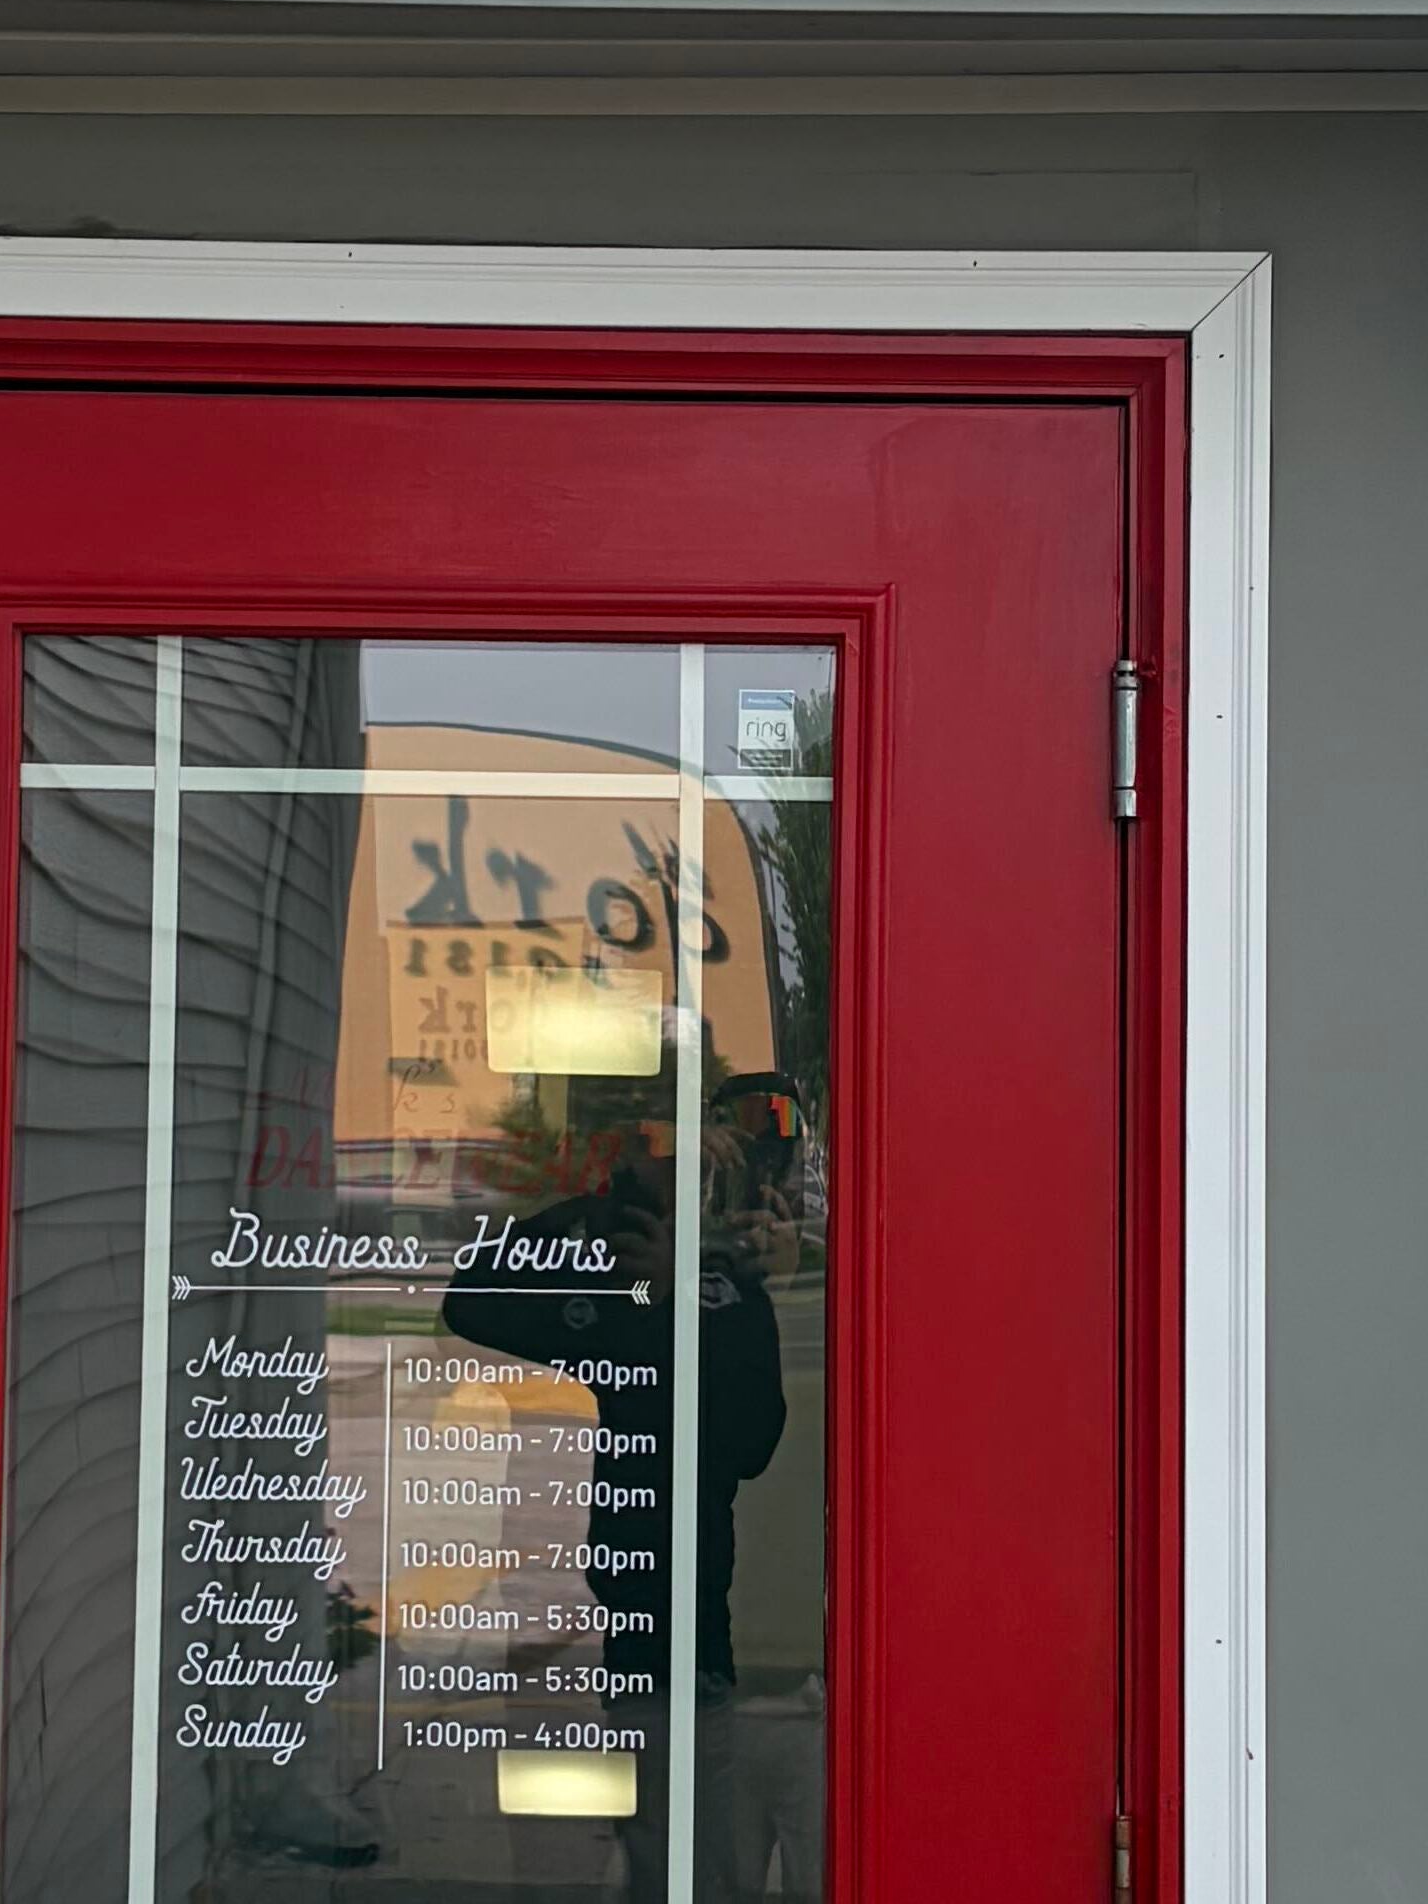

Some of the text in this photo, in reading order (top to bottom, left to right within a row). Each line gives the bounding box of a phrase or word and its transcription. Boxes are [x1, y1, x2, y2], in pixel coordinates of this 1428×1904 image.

[746, 716, 787, 743] ring
[211, 1207, 616, 1272] Business Hours
[185, 1335, 330, 1395] Monday
[404, 1358, 523, 1384] 10:00am
[550, 1359, 657, 1391] 7:00pm
[184, 1396, 328, 1457] Tuesday
[403, 1426, 522, 1452] 10:00am
[549, 1427, 656, 1459] 7:00pm
[180, 1456, 367, 1519] Wednesday
[403, 1480, 521, 1506] 10:00am
[548, 1480, 655, 1513] 7:00pm
[181, 1519, 347, 1581] Thursday
[400, 1542, 520, 1569] 10:00am
[547, 1543, 655, 1576] 7:00pm
[399, 1603, 519, 1630] 10:00am
[547, 1604, 653, 1638] 5:30pm
[177, 1642, 338, 1704] Saturday
[398, 1665, 518, 1692] 10:00am
[546, 1666, 653, 1699] 5:30pm
[176, 1704, 306, 1766] Sunday
[403, 1721, 507, 1754] 1:00pm
[534, 1722, 645, 1755] 4:00pm
